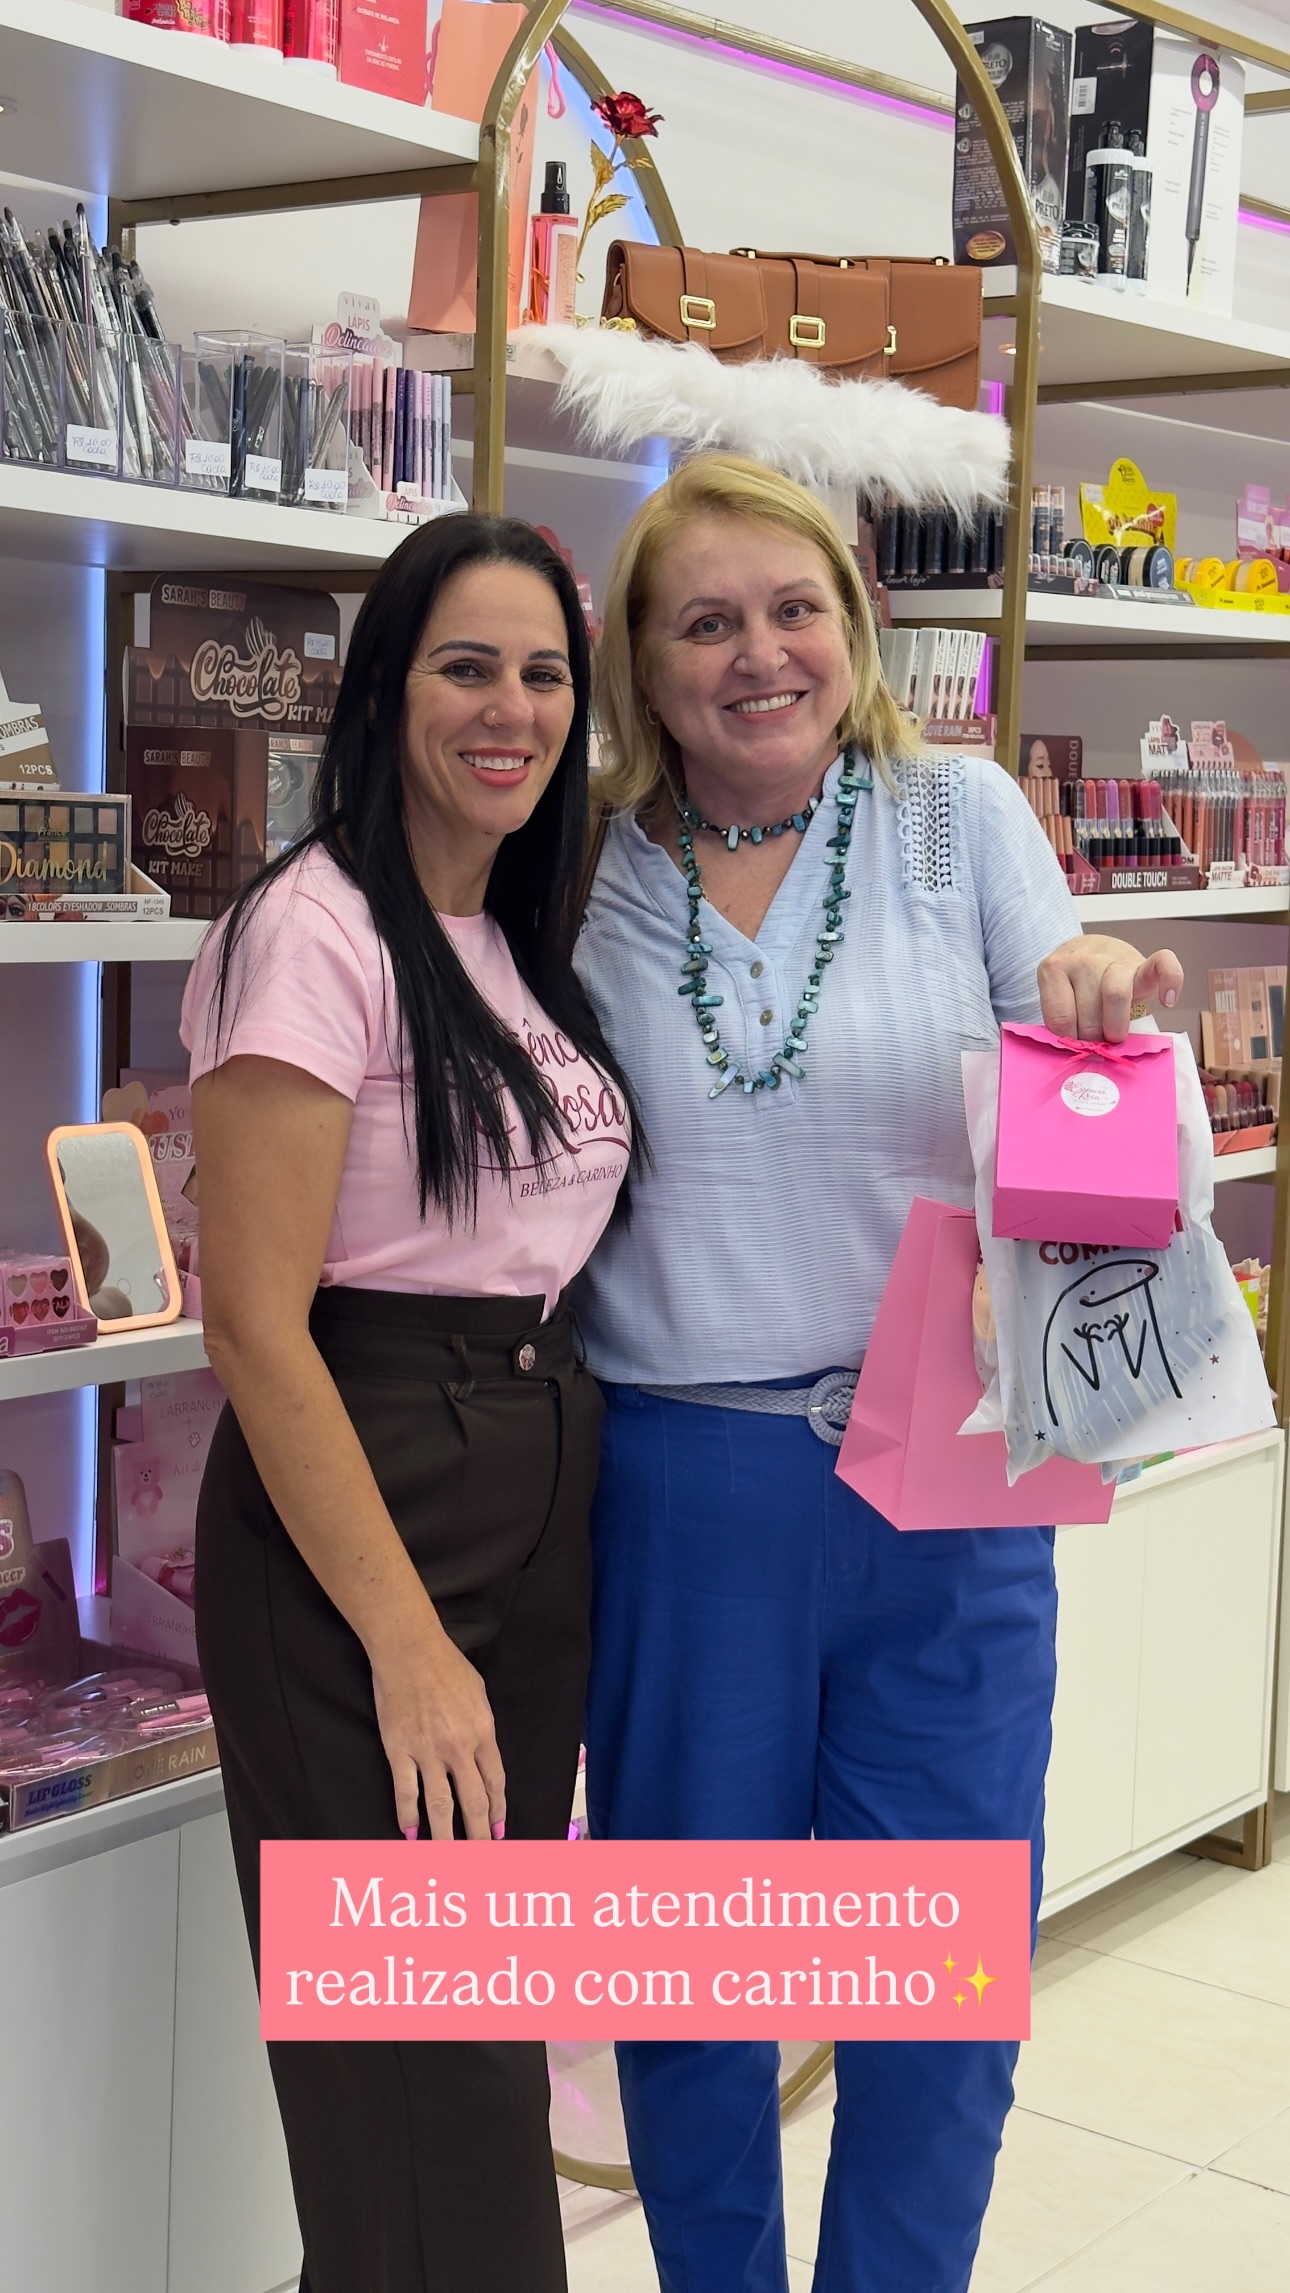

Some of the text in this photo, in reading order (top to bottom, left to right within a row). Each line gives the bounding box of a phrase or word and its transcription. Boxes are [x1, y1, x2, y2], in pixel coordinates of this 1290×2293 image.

[348, 313, 370, 332] LÁPIS
[162, 584, 247, 611] SARAH'S BEAUTY
[192, 643, 300, 717] Chocolate
[288, 704, 335, 724] KIT MA
[0, 716, 39, 739] OMBRAS
[19, 764, 53, 775] 12PCS
[143, 808, 211, 857] Chocolate
[0, 840, 108, 884] Diamond
[148, 860, 204, 876] KIT MAKE
[1111, 872, 1141, 889] DOUBLE
[1143, 871, 1168, 887] TOUCH
[143, 907, 164, 915] 12PCS
[519, 1176, 568, 1198] BELEZA
[576, 1164, 624, 1185] CARINHO
[1038, 1240, 1121, 1265] COM
[168, 1744, 207, 1771] RAIN
